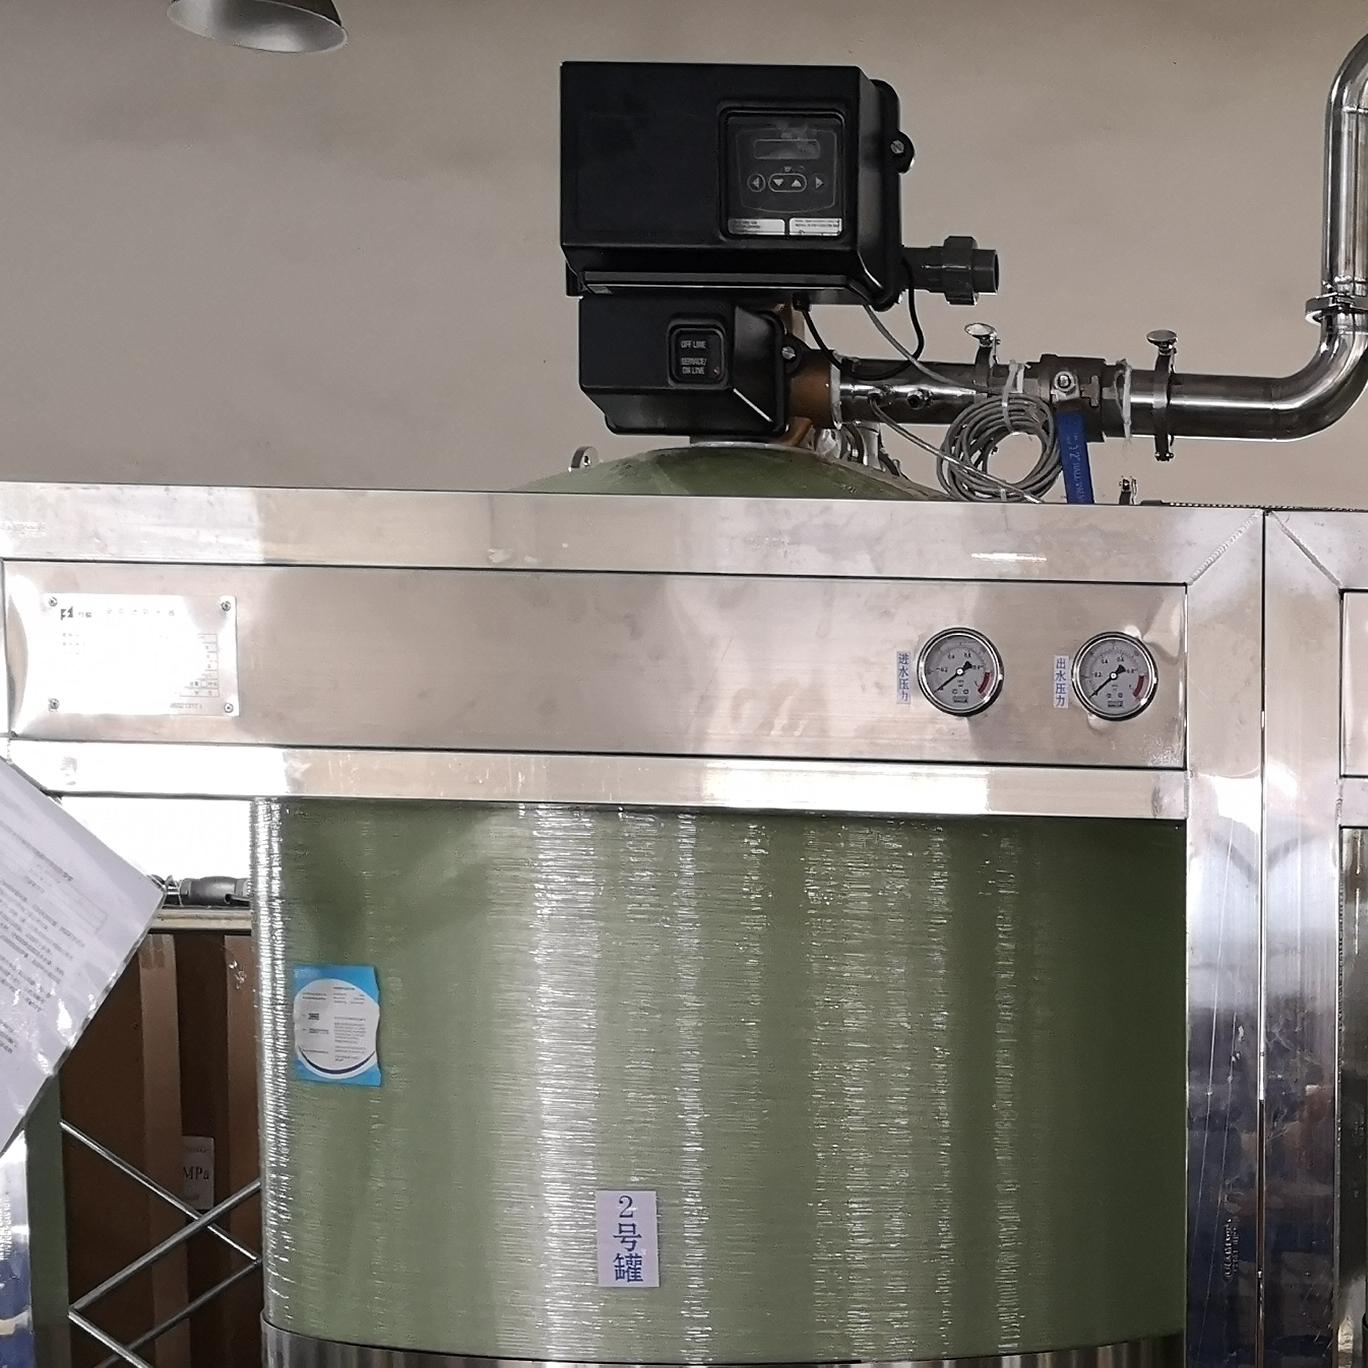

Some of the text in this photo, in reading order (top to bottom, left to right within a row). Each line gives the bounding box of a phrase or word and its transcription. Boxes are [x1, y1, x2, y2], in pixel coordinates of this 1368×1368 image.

[898, 652, 910, 702] 进水压力
[1056, 657, 1067, 707] 出水压力
[612, 1194, 644, 1282] 2号罐
